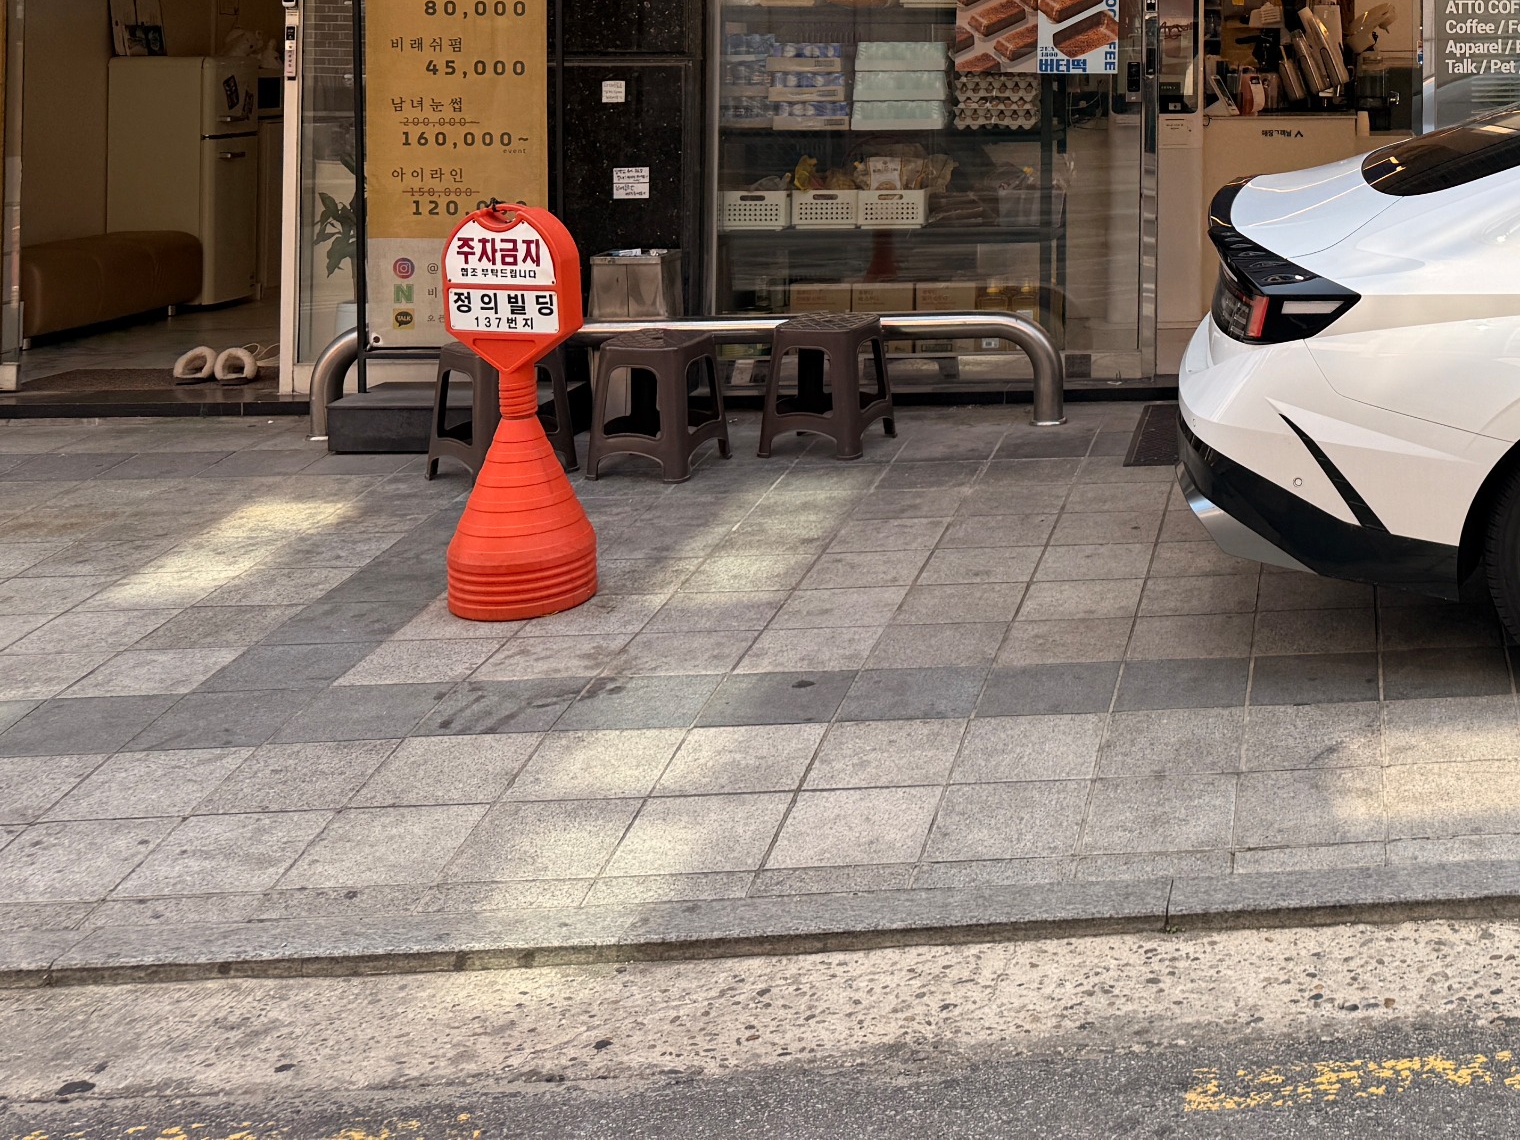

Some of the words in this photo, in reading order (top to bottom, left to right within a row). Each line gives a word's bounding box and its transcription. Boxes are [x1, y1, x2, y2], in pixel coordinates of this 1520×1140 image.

[424, 0, 526, 19] 80,000
[1445, 19, 1495, 34] Coffee
[390, 36, 463, 53] 비래쉬펌
[1445, 39, 1502, 57] Apparel
[425, 59, 526, 79] 45,000
[1039, 58, 1087, 73] 버터떡
[1445, 59, 1478, 74] Talk
[1490, 60, 1516, 74] Pet
[390, 96, 463, 113] 남녀눈썹
[402, 131, 529, 149] 160,000~
[391, 167, 464, 183] 아이라인
[456, 237, 541, 267] 주차금지
[460, 267, 478, 277] 협조
[481, 268, 537, 279] 부탁드립니다
[453, 291, 555, 317] 정의빌딩
[474, 316, 534, 330] 137번지
